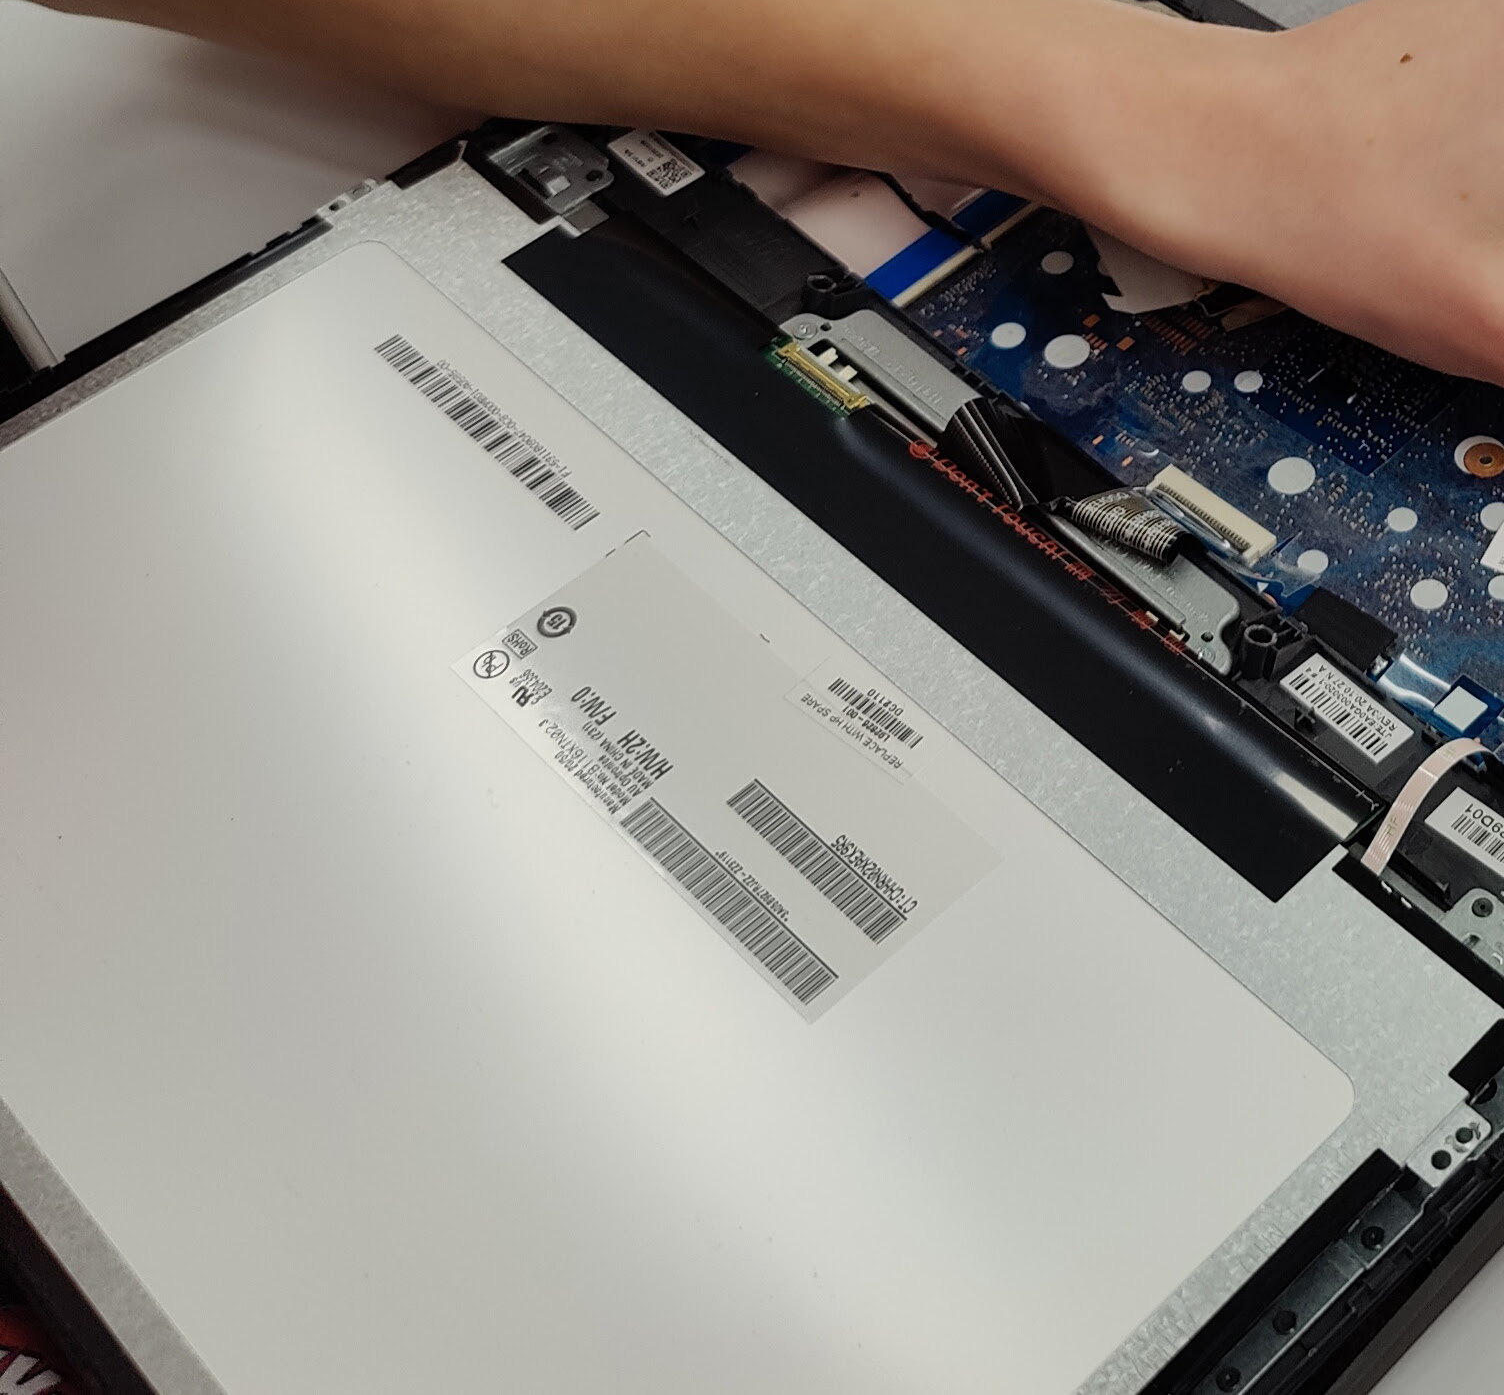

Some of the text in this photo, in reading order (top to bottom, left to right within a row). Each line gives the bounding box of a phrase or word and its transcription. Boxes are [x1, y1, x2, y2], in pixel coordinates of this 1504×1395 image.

[546, 613, 567, 630] 15
[506, 631, 533, 656] RoHS
[866, 687, 904, 716] DC2110
[1332, 677, 1367, 706] 20.10.27
[569, 684, 674, 780] H/W:2H F/W:0
[800, 692, 904, 769] REPLACE WITH HP SPARE
[598, 737, 625, 761] CHINA
[597, 753, 643, 797] AU Optronics
[619, 756, 633, 770] IN
[571, 766, 623, 814] Manufactured
[628, 765, 654, 789] MADE
[602, 778, 632, 804] Model
